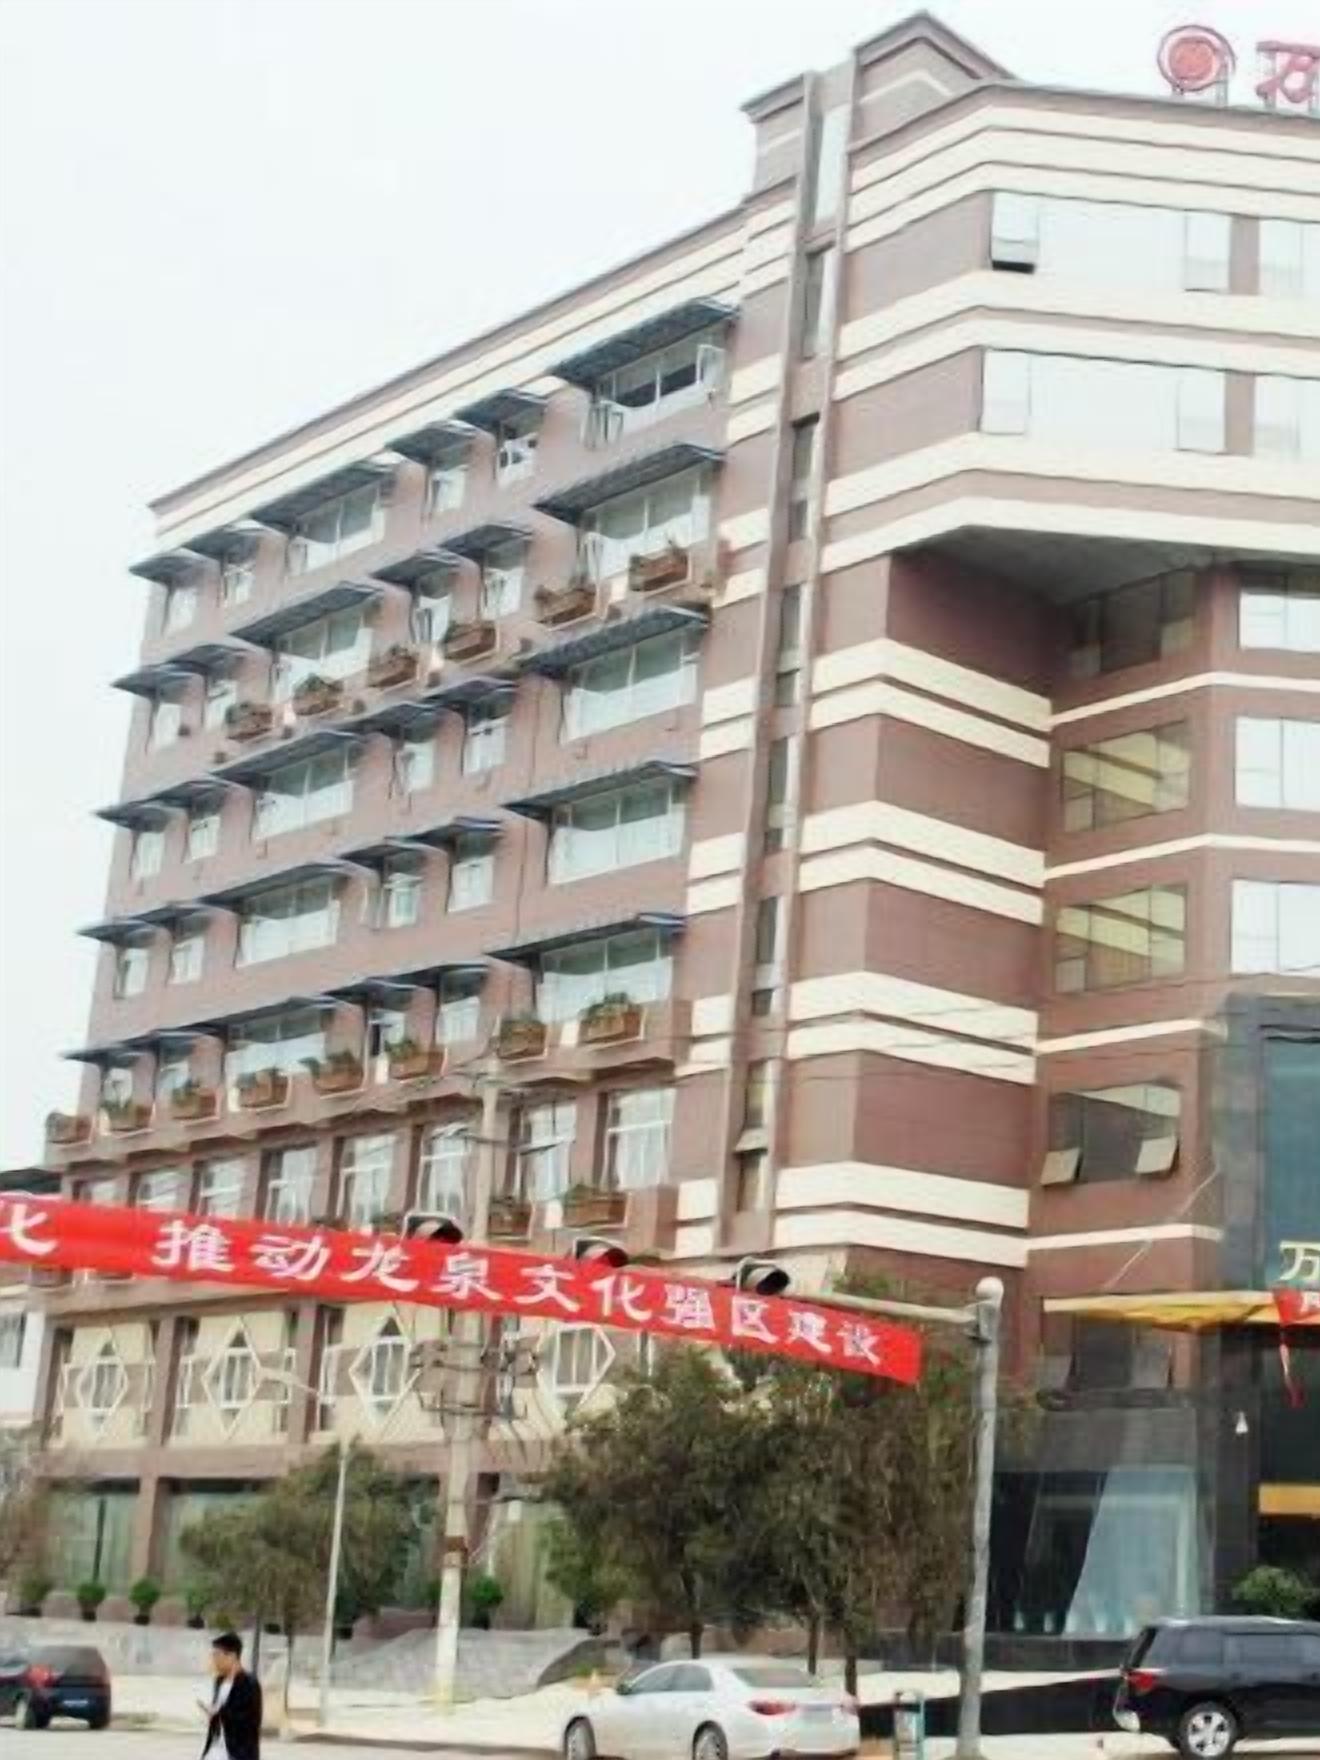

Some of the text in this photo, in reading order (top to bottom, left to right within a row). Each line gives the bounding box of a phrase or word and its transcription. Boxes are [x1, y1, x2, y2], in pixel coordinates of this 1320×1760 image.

[151, 1219, 882, 1366] 推动龙泉文化强区建设
